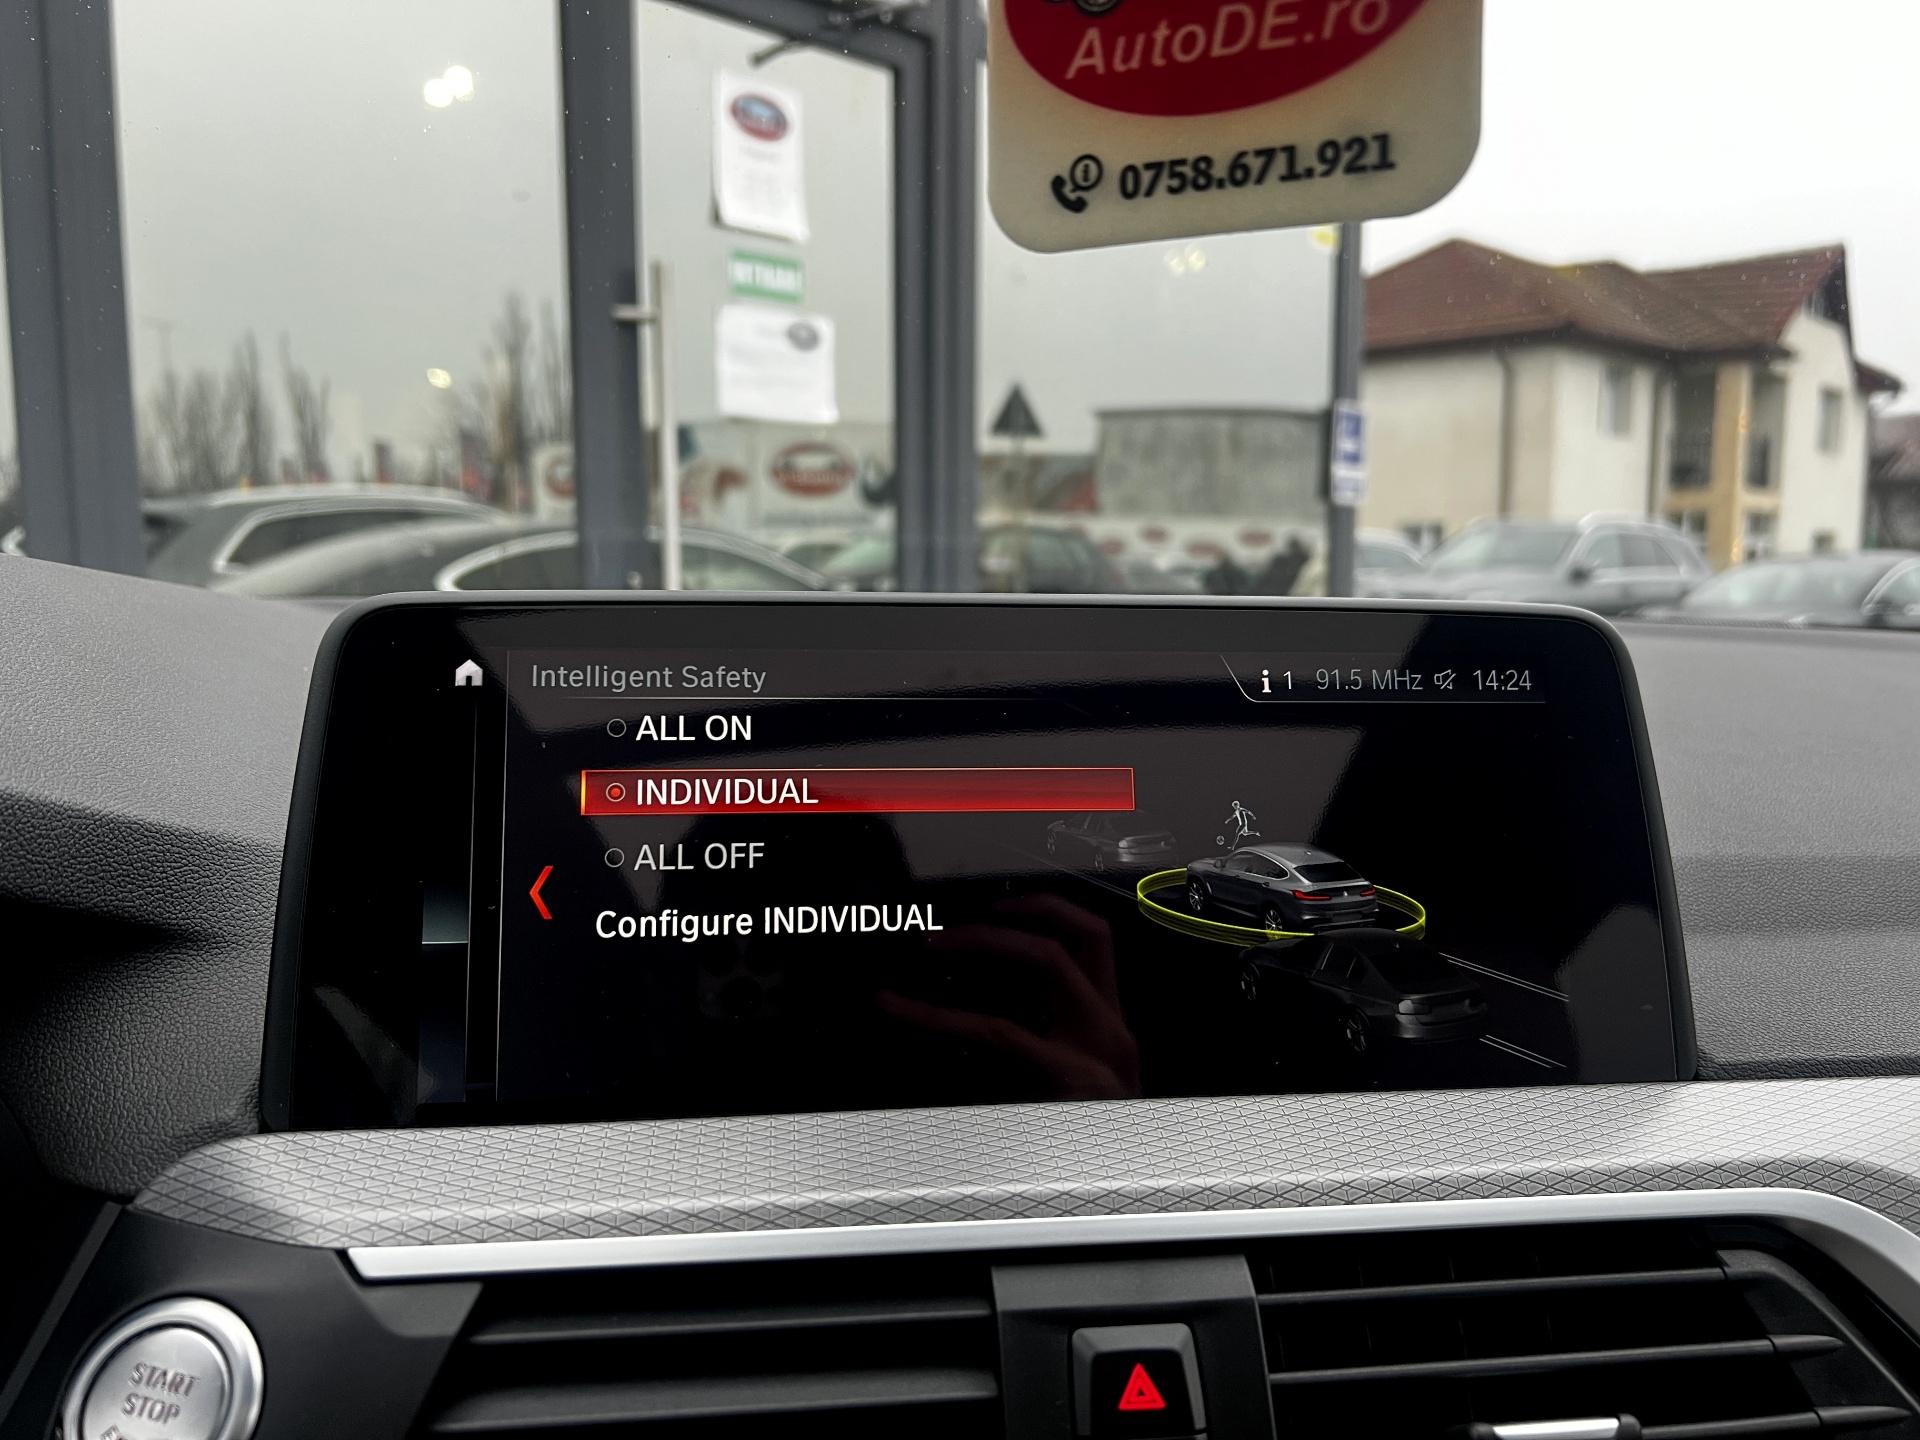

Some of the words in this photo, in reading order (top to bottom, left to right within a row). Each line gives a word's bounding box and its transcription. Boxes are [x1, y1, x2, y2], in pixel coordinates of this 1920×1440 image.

[1065, 0, 1389, 80] AutoDE.ro
[1119, 132, 1396, 200] 0758.671.921
[531, 664, 673, 692] Intelligent
[681, 664, 767, 693] Safety
[1316, 668, 1363, 690] 91.5
[1372, 669, 1424, 690] MHz
[1473, 669, 1532, 691] 14:24
[636, 715, 696, 741] ALL
[705, 714, 753, 741] ON
[636, 778, 819, 805] INDIVIDUAL
[634, 843, 694, 871] ALL
[704, 842, 765, 870] OFF
[596, 908, 753, 943] Configure
[764, 904, 944, 934] INDIVIDUAL
[130, 1362, 200, 1397] START
[121, 1392, 180, 1424] STOP
